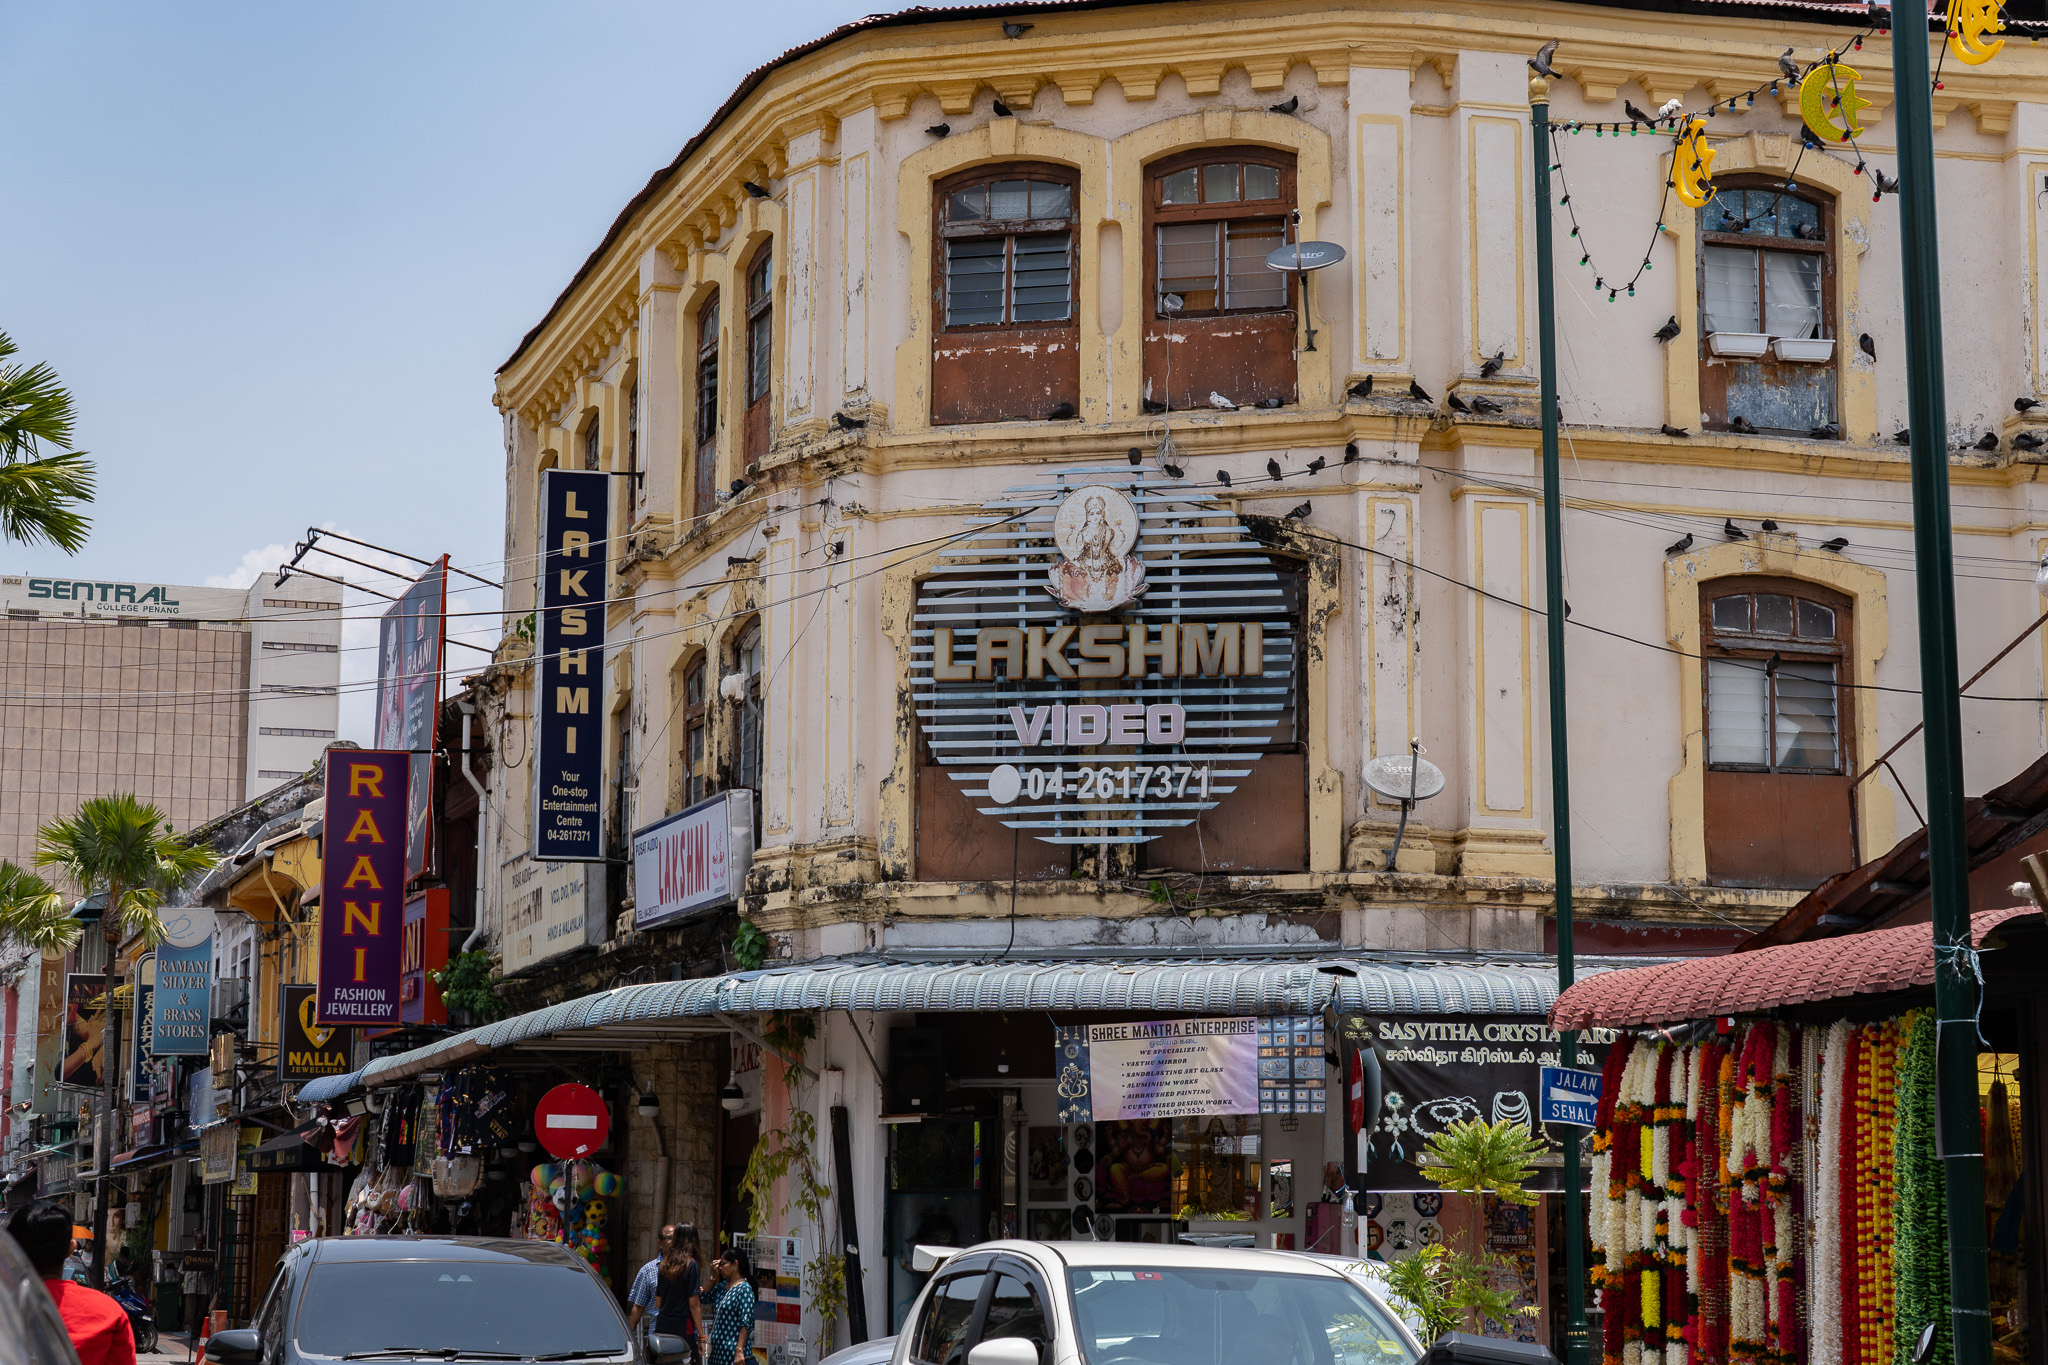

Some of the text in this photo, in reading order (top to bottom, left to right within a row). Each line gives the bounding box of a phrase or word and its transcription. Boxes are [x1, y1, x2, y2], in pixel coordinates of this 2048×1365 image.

[97, 603, 180, 614] COLLEGE PENANG
[556, 490, 589, 754] LAKSHMI
[933, 622, 1263, 682] LAKSHMI
[1008, 704, 1186, 747] VIDEO
[561, 770, 580, 782] Your
[1027, 765, 1213, 801] 04-2617371
[552, 785, 588, 799] One-stop
[543, 799, 597, 813] Entertainment
[556, 815, 583, 827] Centre
[547, 829, 591, 842] 04-2617371
[658, 820, 710, 906] LAKSHMI
[341, 762, 386, 983] RAANI
[159, 960, 210, 974] RAMANI
[162, 976, 206, 989] SILVER
[177, 992, 188, 1006] &
[334, 988, 385, 1002] FASHION
[163, 1008, 202, 1022] BRASS
[326, 1003, 393, 1017] JEWELLERY
[158, 1025, 206, 1039] STORES
[1092, 1020, 1255, 1041] SHREE MANTRA ENTERPRISE
[1379, 1022, 1483, 1041] SASVITHA
[1483, 1023, 1561, 1042] CRYSTA
[1153, 1047, 1196, 1055] SPECIALIZE
[1386, 1046, 1458, 1066] சஸ்விதா
[1460, 1047, 1535, 1066] கிரிஸ்டல்
[288, 1052, 346, 1066] NALLA
[291, 1066, 344, 1074] JEWELLERS
[1126, 1069, 1183, 1078] SANDBLASTING
[1126, 1080, 1171, 1089] ALUMINIUM
[1556, 1072, 1598, 1092] JALAN
[1126, 1089, 1211, 1100] AIRBRUSHED PAINTING
[1127, 1102, 1176, 1110] CUSTOMISED
